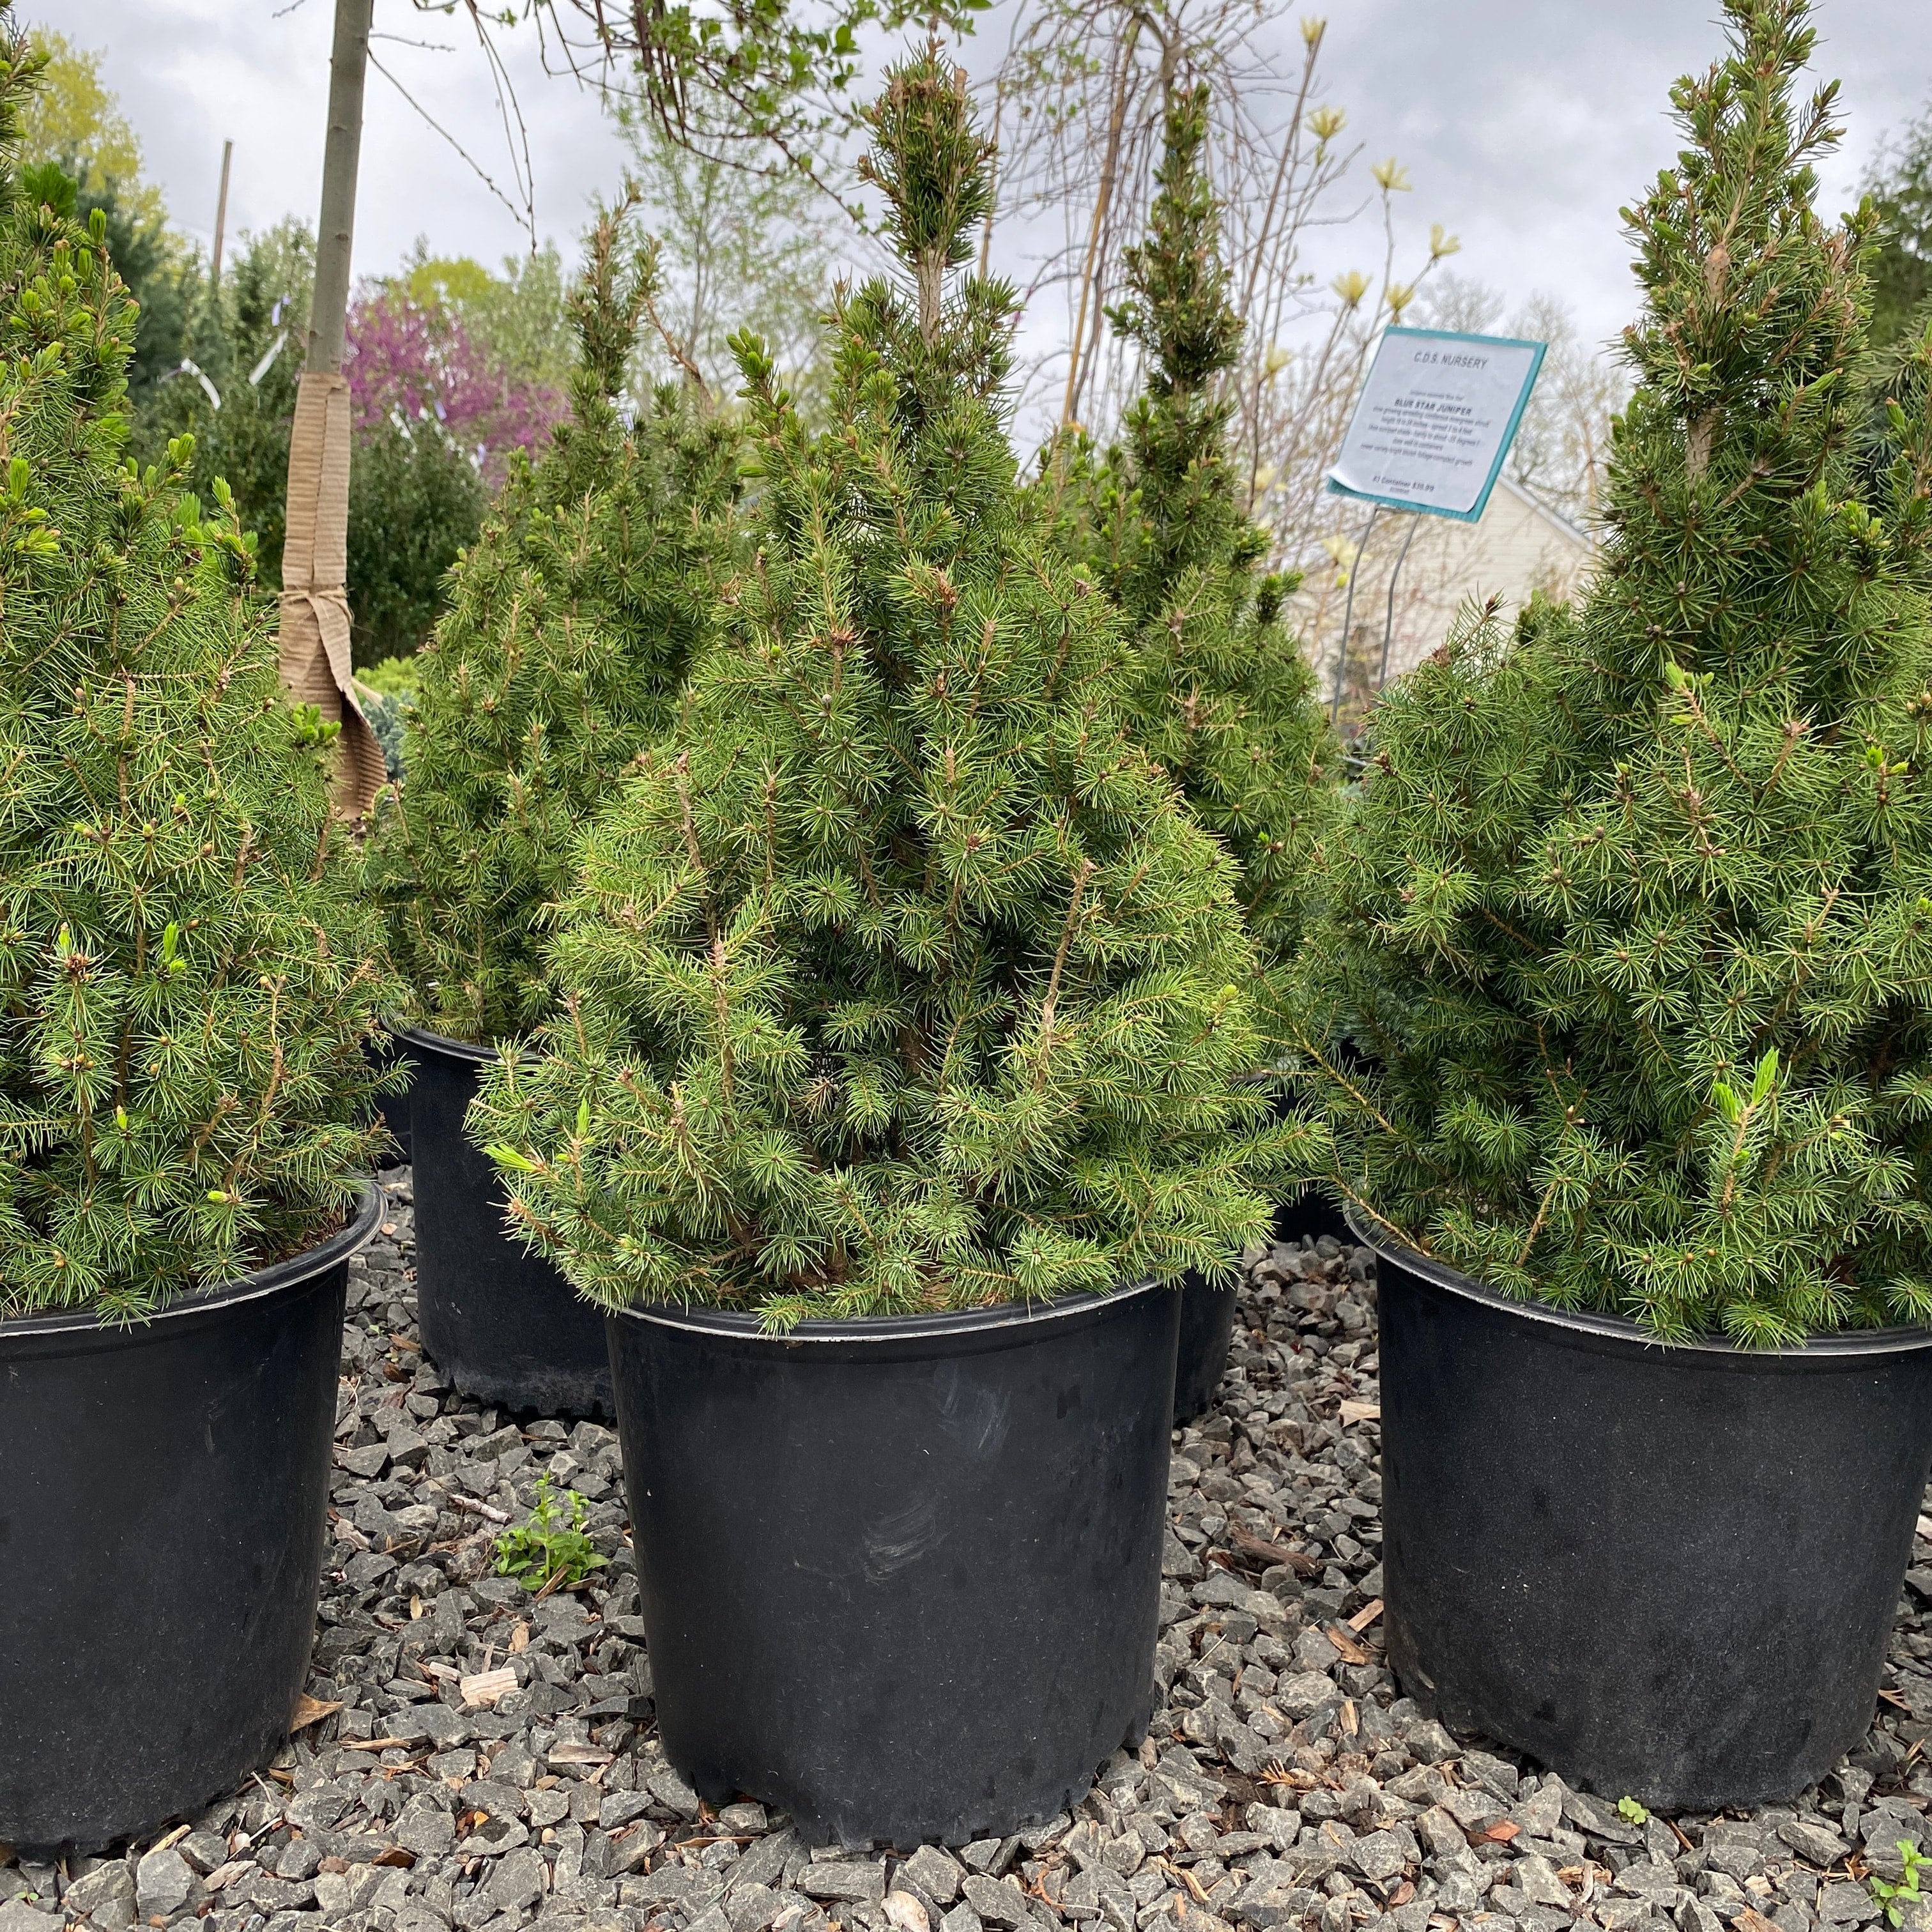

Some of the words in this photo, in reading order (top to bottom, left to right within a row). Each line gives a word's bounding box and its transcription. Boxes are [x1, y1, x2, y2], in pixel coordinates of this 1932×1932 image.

[1441, 355, 1488, 370] NURSERY
[1395, 399, 1414, 408] BLUE
[1414, 401, 1436, 411] STAR
[1436, 403, 1472, 417] JUNIPER
